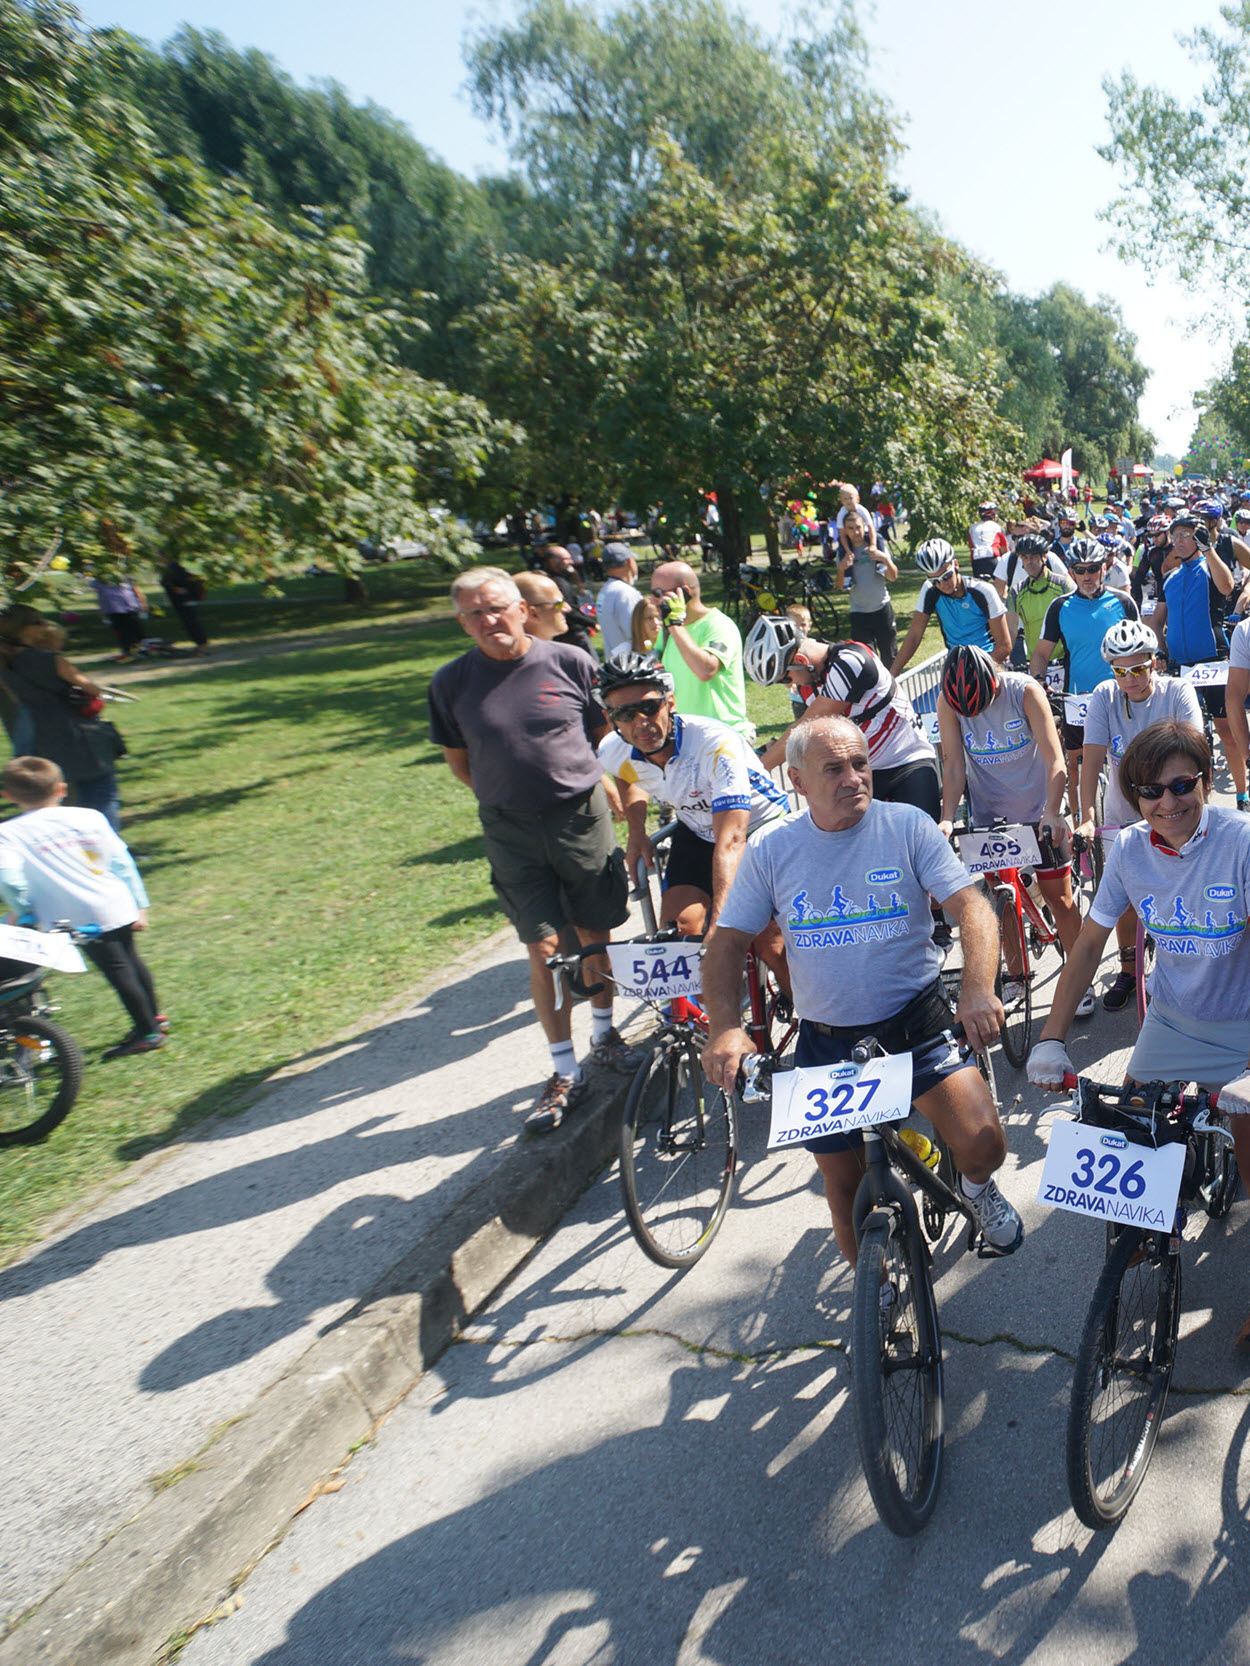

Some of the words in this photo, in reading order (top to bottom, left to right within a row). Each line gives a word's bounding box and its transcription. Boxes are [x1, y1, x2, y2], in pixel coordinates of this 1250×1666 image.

[1192, 668, 1219, 680] 457
[980, 838, 1021, 858] 495
[870, 870, 898, 882] Dukat
[1209, 888, 1234, 897] Dukat
[795, 919, 909, 949] ZDRAVANAVIKA
[633, 955, 692, 986] 544
[623, 980, 701, 998] ZDRAVANAVIK
[831, 1067, 856, 1079] Dukat
[805, 1078, 882, 1122] 327
[776, 1107, 902, 1143] ZDRAVANAVIKA
[1103, 1137, 1127, 1149] Dukat
[1071, 1149, 1147, 1200] 326
[1044, 1184, 1165, 1227] ZDRAVANAVIKA
